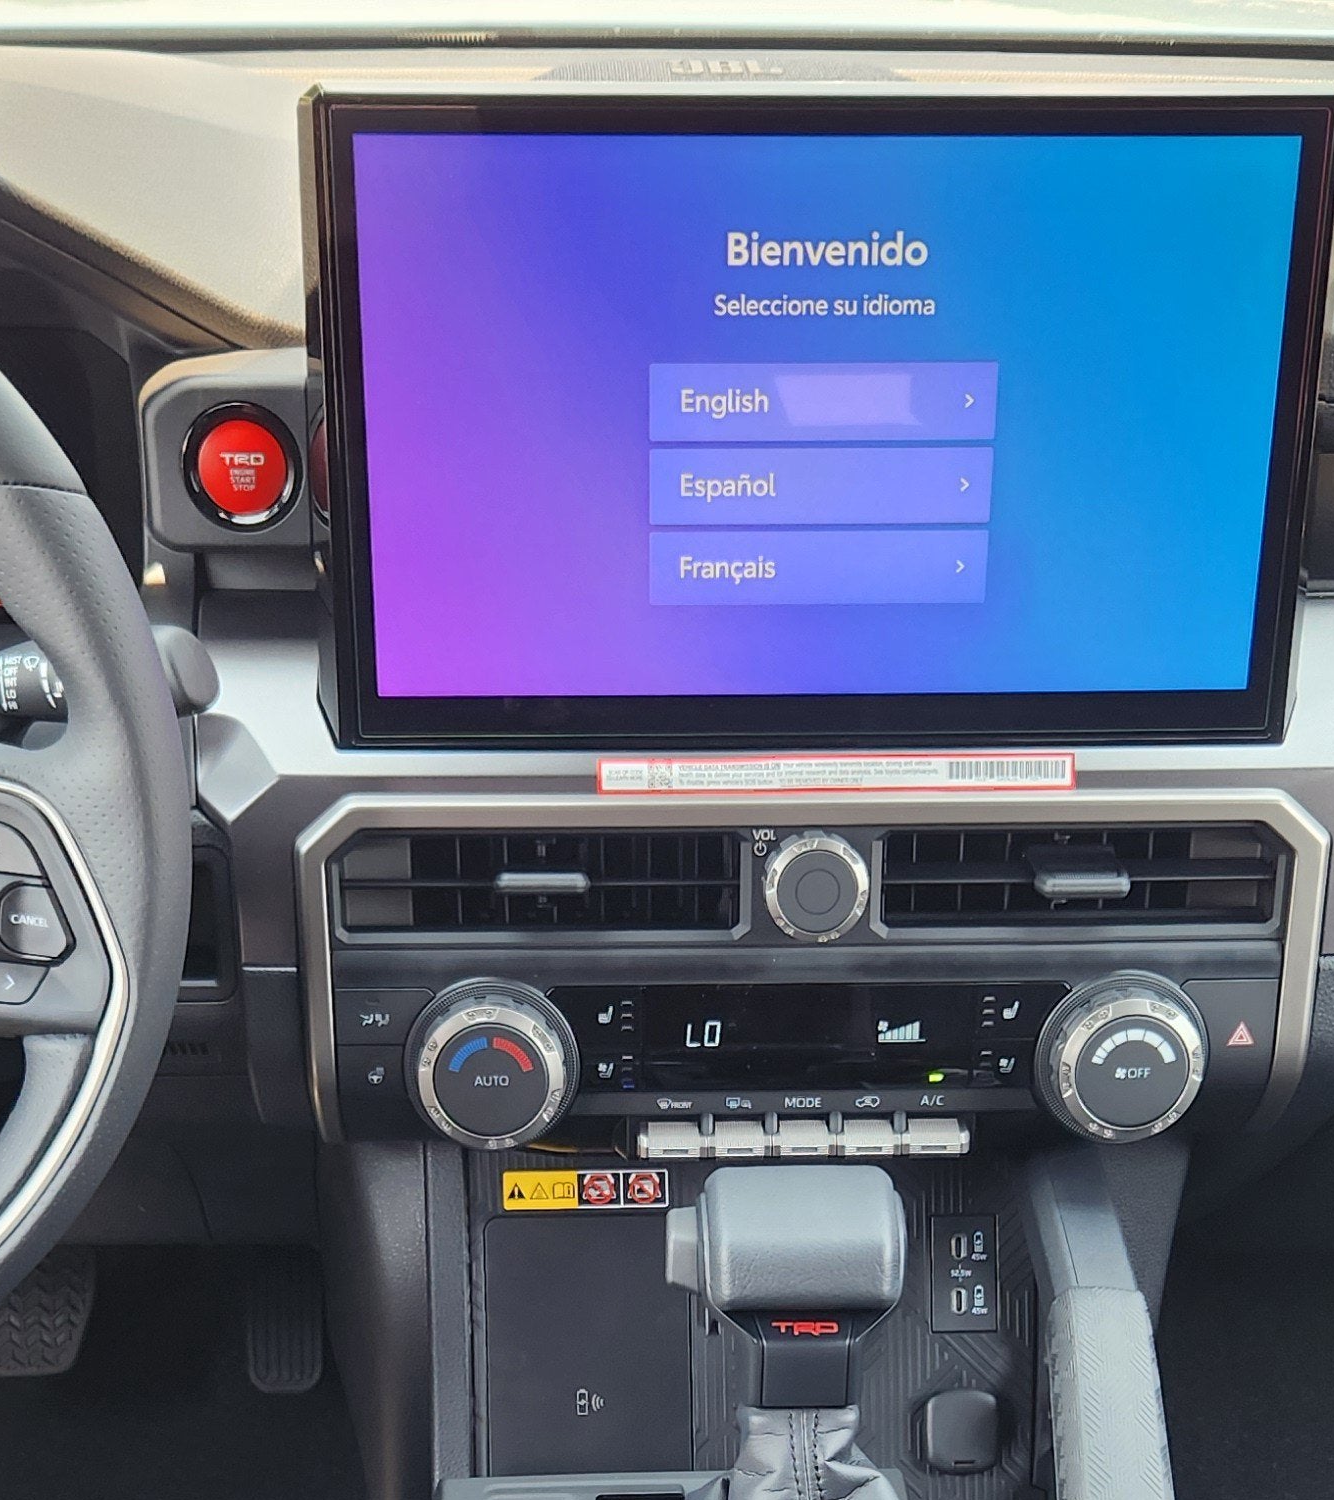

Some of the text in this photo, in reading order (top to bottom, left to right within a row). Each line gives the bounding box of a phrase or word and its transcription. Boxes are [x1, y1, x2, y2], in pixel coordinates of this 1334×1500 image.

[726, 231, 929, 267] Bienvenido
[713, 294, 937, 317] Seleccione su idioma
[679, 387, 770, 419] English
[219, 451, 265, 466] TRD
[229, 476, 256, 484] START
[232, 484, 256, 492] STOP
[679, 472, 777, 503] Español
[679, 556, 777, 585] Français
[4, 666, 18, 676] OFF
[5, 688, 17, 699] LO
[752, 829, 777, 842] VOL
[10, 914, 48, 928] CANCEL
[685, 1019, 722, 1048] LO
[1127, 1067, 1152, 1080] OFF
[473, 1074, 510, 1088] AUTO
[784, 1097, 822, 1109] MODE
[919, 1094, 946, 1107] A/C
[771, 1321, 839, 1336] TRD
